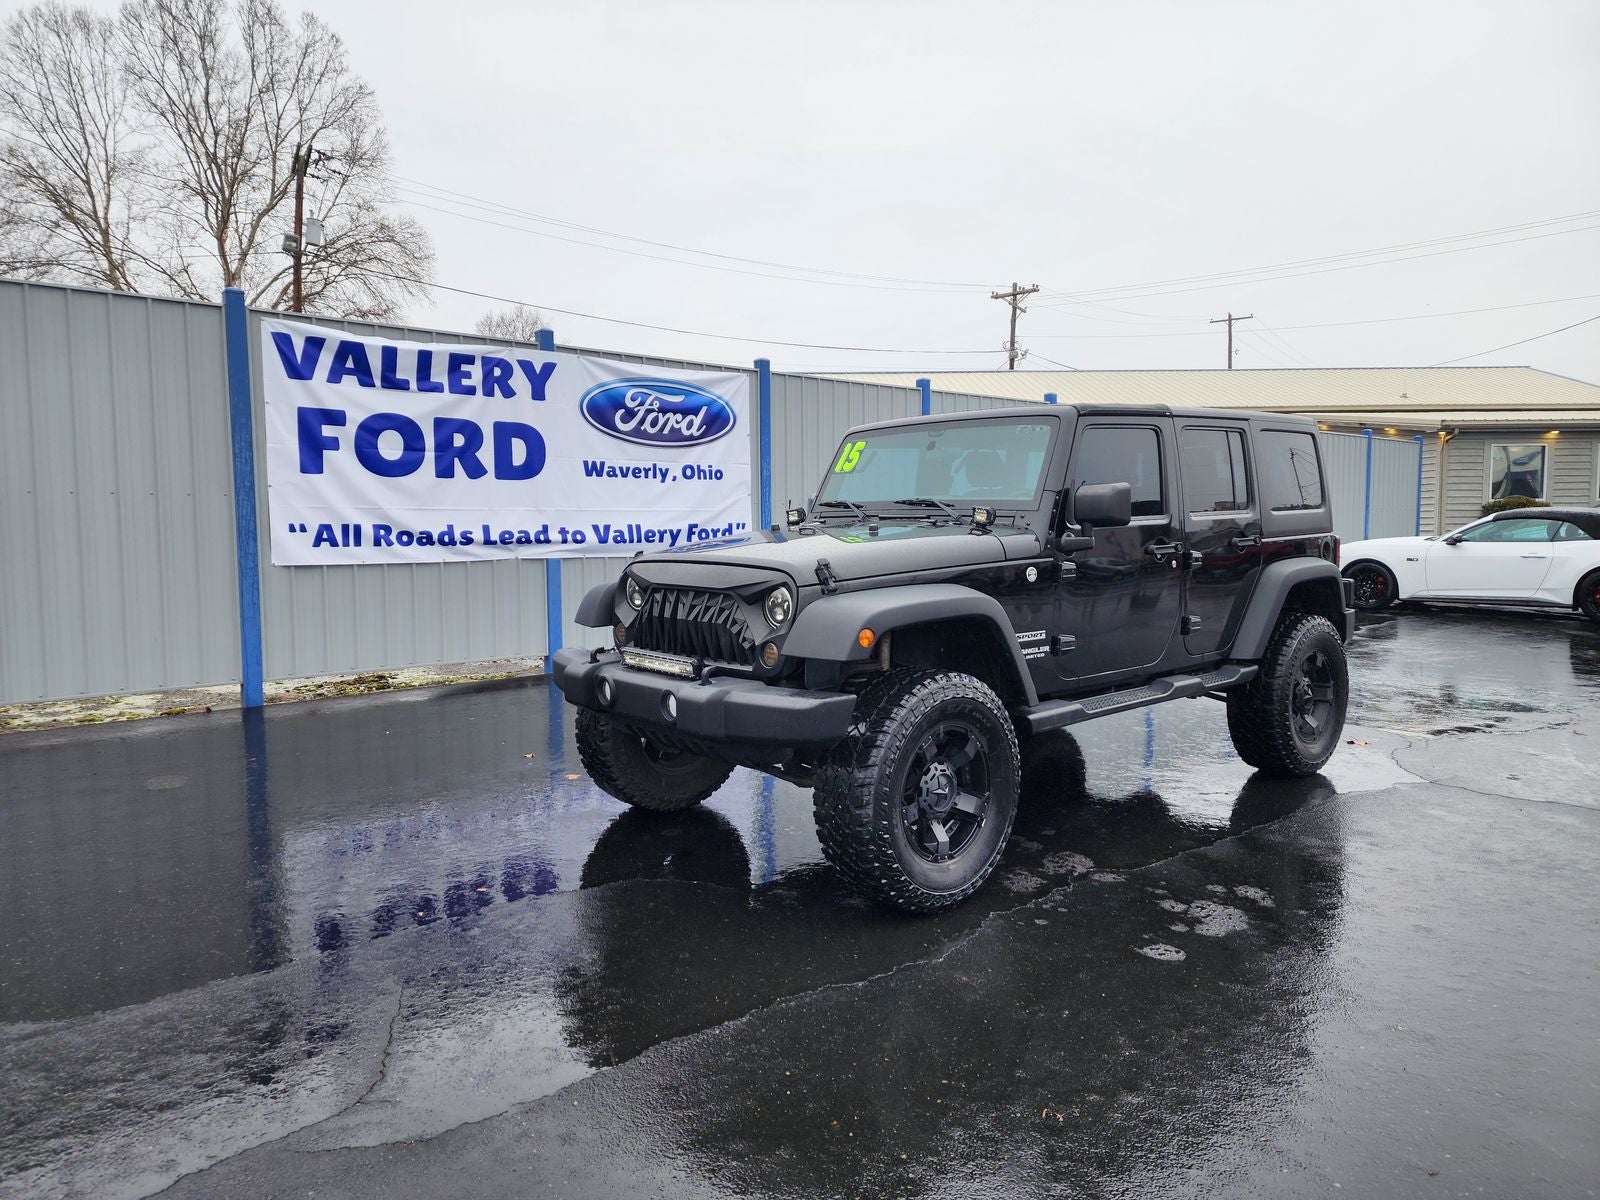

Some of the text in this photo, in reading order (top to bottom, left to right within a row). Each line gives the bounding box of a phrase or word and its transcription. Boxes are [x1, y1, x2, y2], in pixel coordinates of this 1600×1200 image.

[271, 331, 557, 402] VALLERY
[614, 387, 708, 437] Ford
[296, 406, 547, 481] FORD
[834, 441, 867, 473] 15
[582, 459, 724, 484] Waverly, Ohio
[372, 523, 474, 548] Roads
[481, 523, 551, 546] Lead
[558, 526, 587, 545] to
[591, 523, 682, 548] Vallery
[1016, 632, 1043, 640] SPORT
